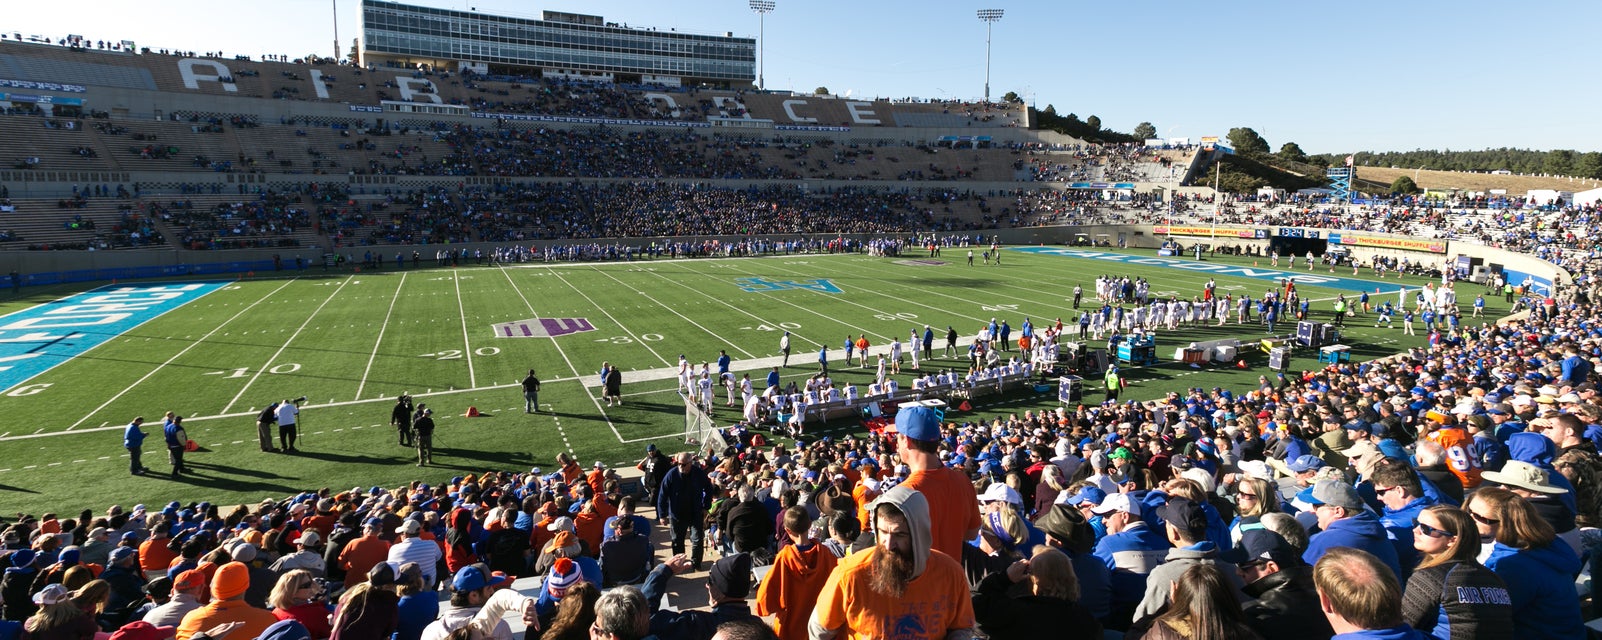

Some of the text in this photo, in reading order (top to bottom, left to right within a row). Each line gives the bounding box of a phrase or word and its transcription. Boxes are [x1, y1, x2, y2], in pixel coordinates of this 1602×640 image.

[1358, 237, 1402, 247] THICKBURGER
[1404, 241, 1430, 249] SHUFFLE
[755, 321, 802, 332] 40
[610, 333, 664, 345] 30
[437, 346, 500, 361] 20
[223, 363, 301, 380] 10
[1457, 586, 1484, 604] AIR
